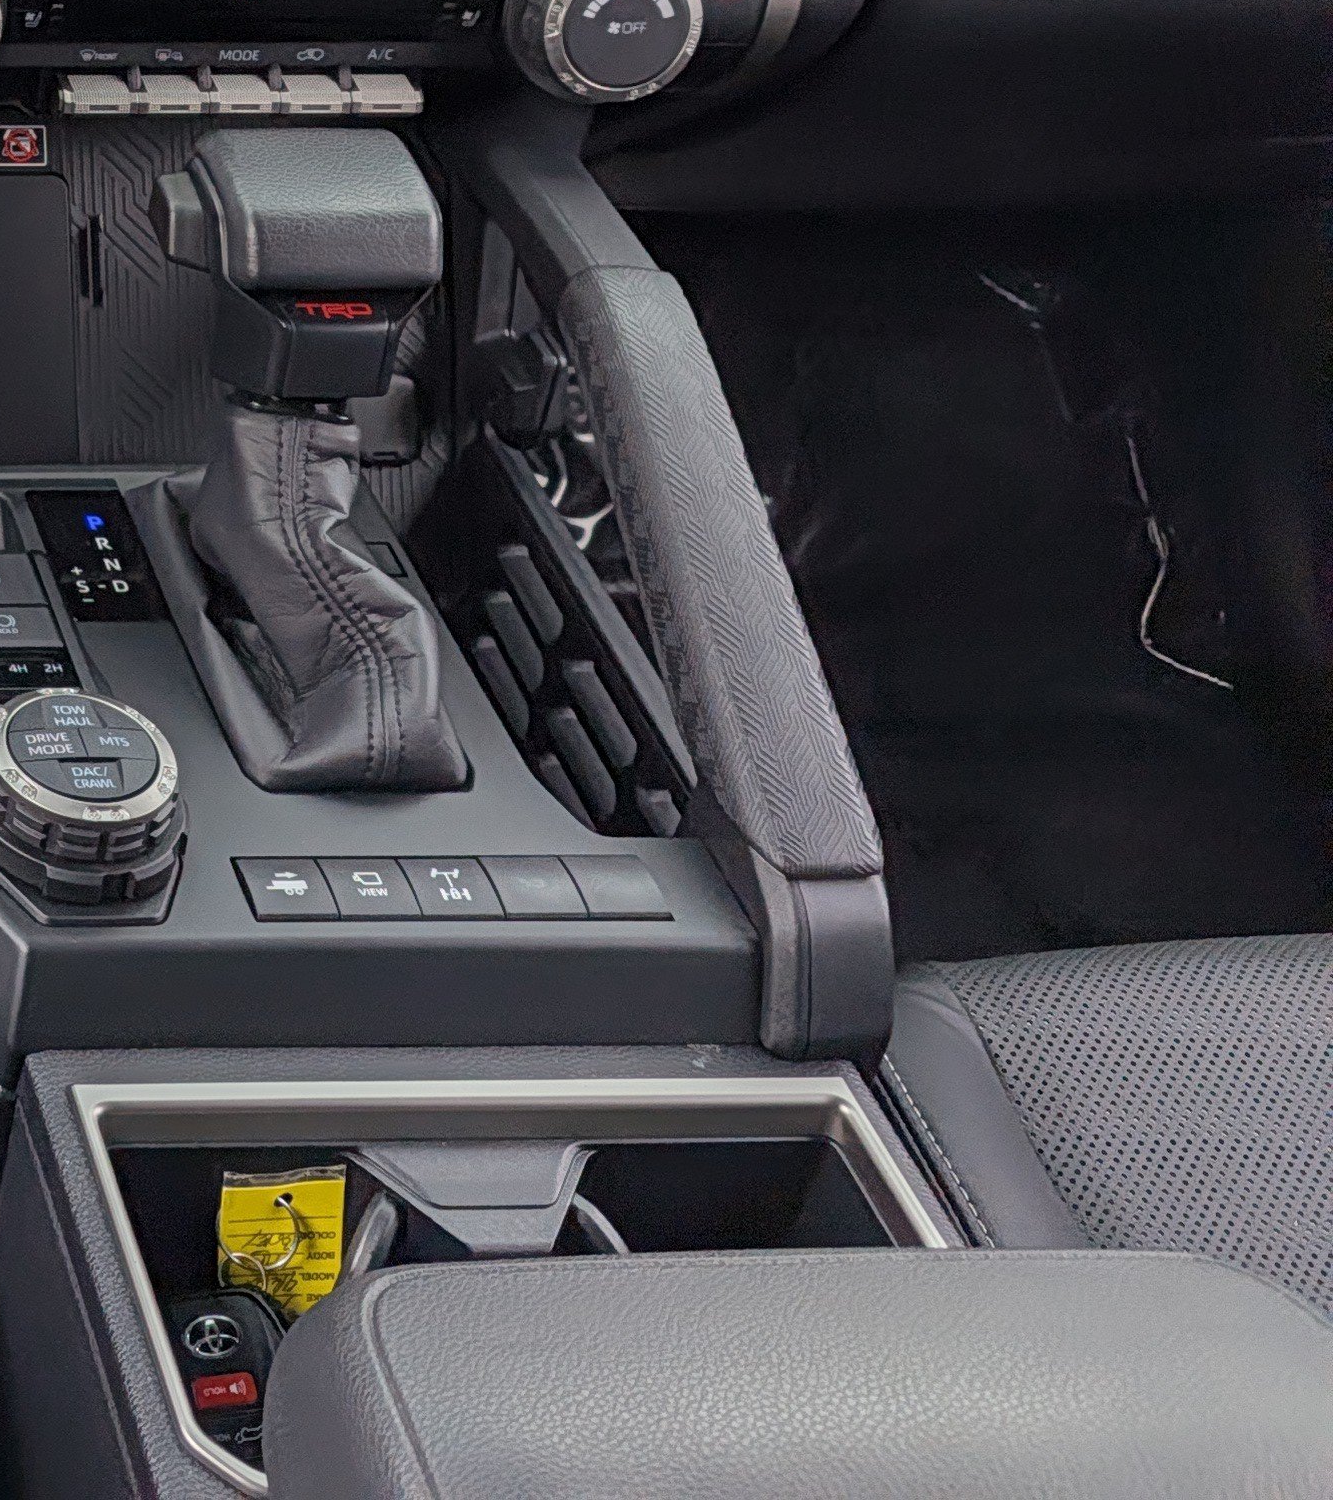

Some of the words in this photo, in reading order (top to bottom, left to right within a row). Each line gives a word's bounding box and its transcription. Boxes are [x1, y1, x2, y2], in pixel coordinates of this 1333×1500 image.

[621, 21, 647, 35] OFF
[219, 49, 261, 62] MODE
[367, 49, 394, 61] A/C
[295, 303, 373, 319] TRD
[86, 514, 105, 531] P
[94, 536, 114, 551] R
[102, 558, 122, 572] N
[75, 580, 90, 593] S
[112, 580, 130, 593] D
[8, 664, 29, 674] 4H
[43, 663, 64, 674] 2H
[53, 705, 86, 715] TOW
[54, 716, 95, 727] HAUL
[25, 732, 70, 744] DRIVE
[98, 736, 130, 748] MTS
[28, 743, 75, 756] MODE
[71, 766, 108, 777] DAC/
[74, 778, 117, 789] CRAWL
[357, 887, 388, 897] VIEW
[305, 1252, 336, 1260] BODY
[298, 1272, 335, 1280] MODEL
